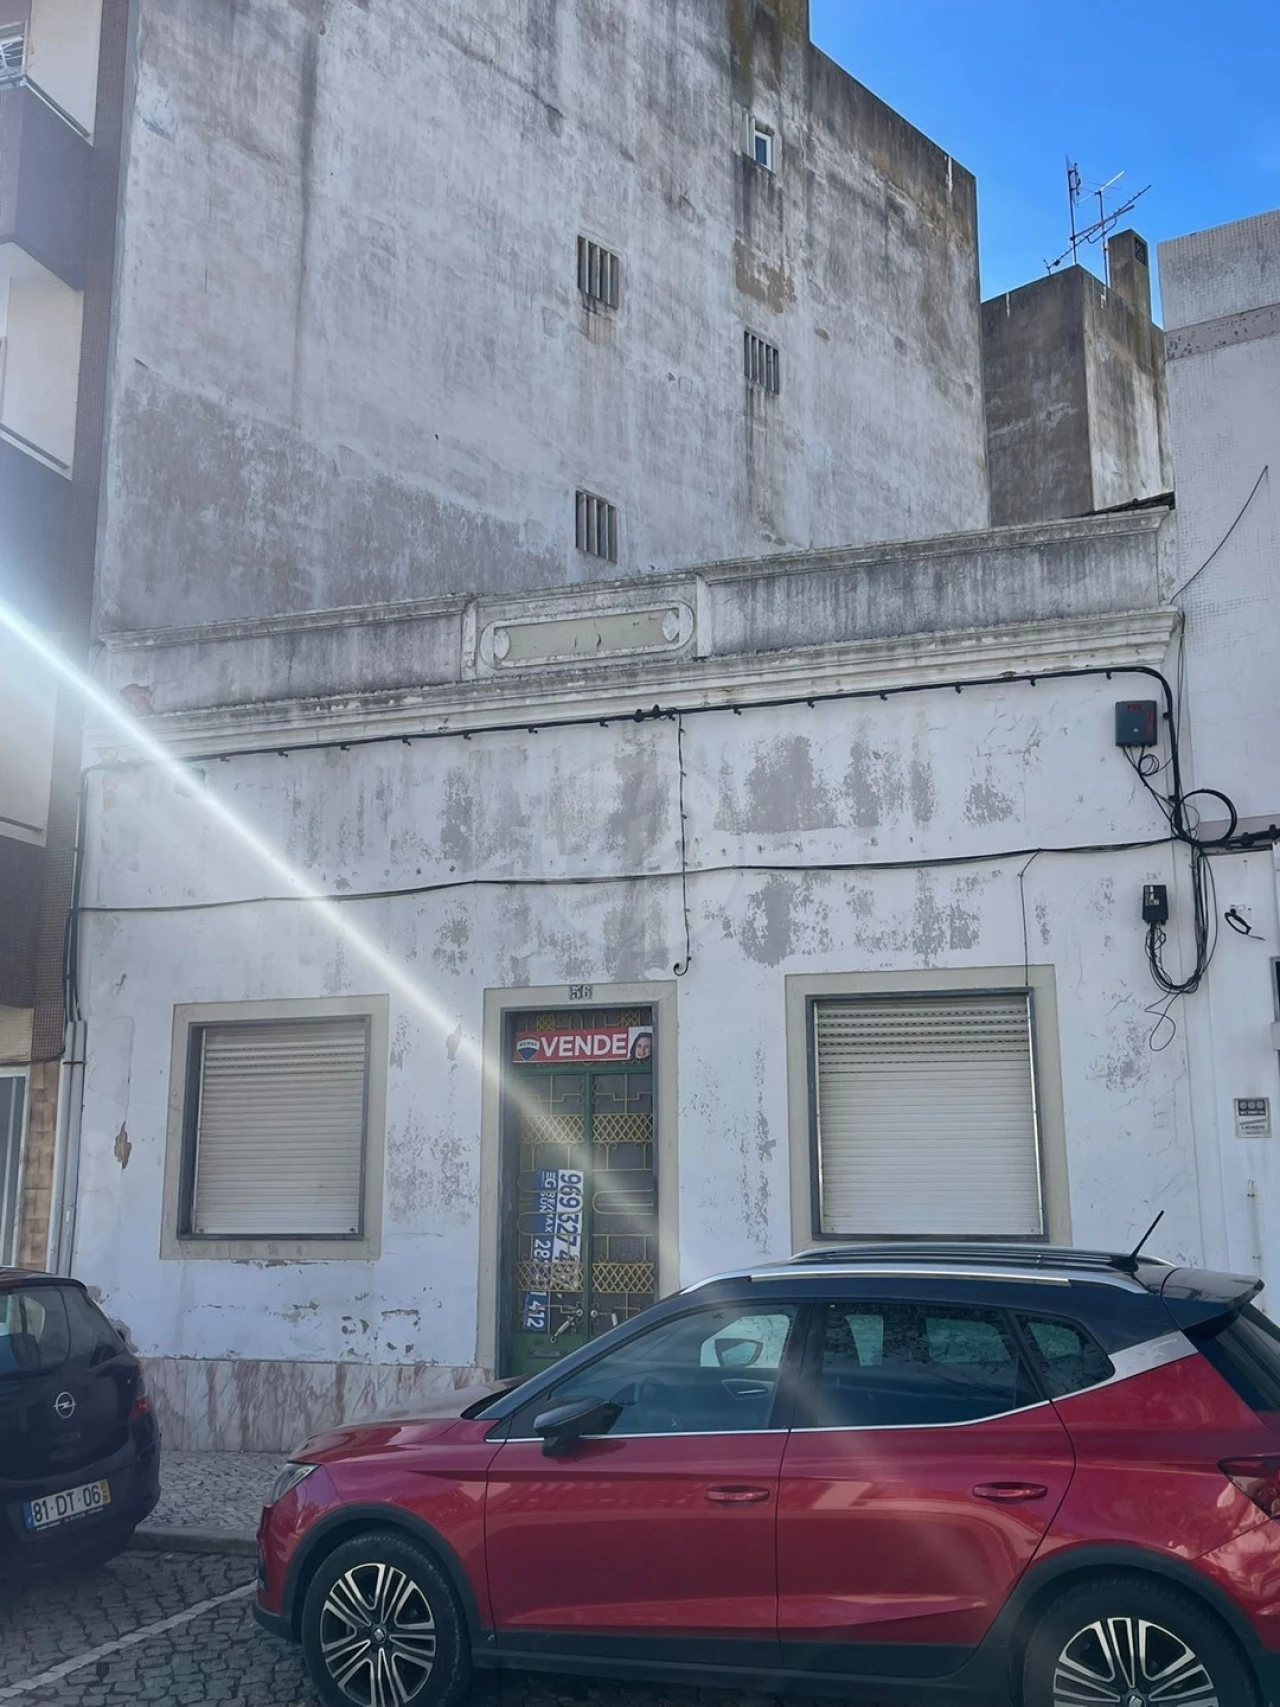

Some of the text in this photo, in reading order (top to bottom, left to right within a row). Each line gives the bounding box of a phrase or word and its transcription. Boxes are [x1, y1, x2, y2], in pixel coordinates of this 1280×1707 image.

[571, 986, 591, 999] 56
[540, 1033, 627, 1057] VENDE
[558, 1173, 582, 1209] 969
[556, 1213, 579, 1247] 327
